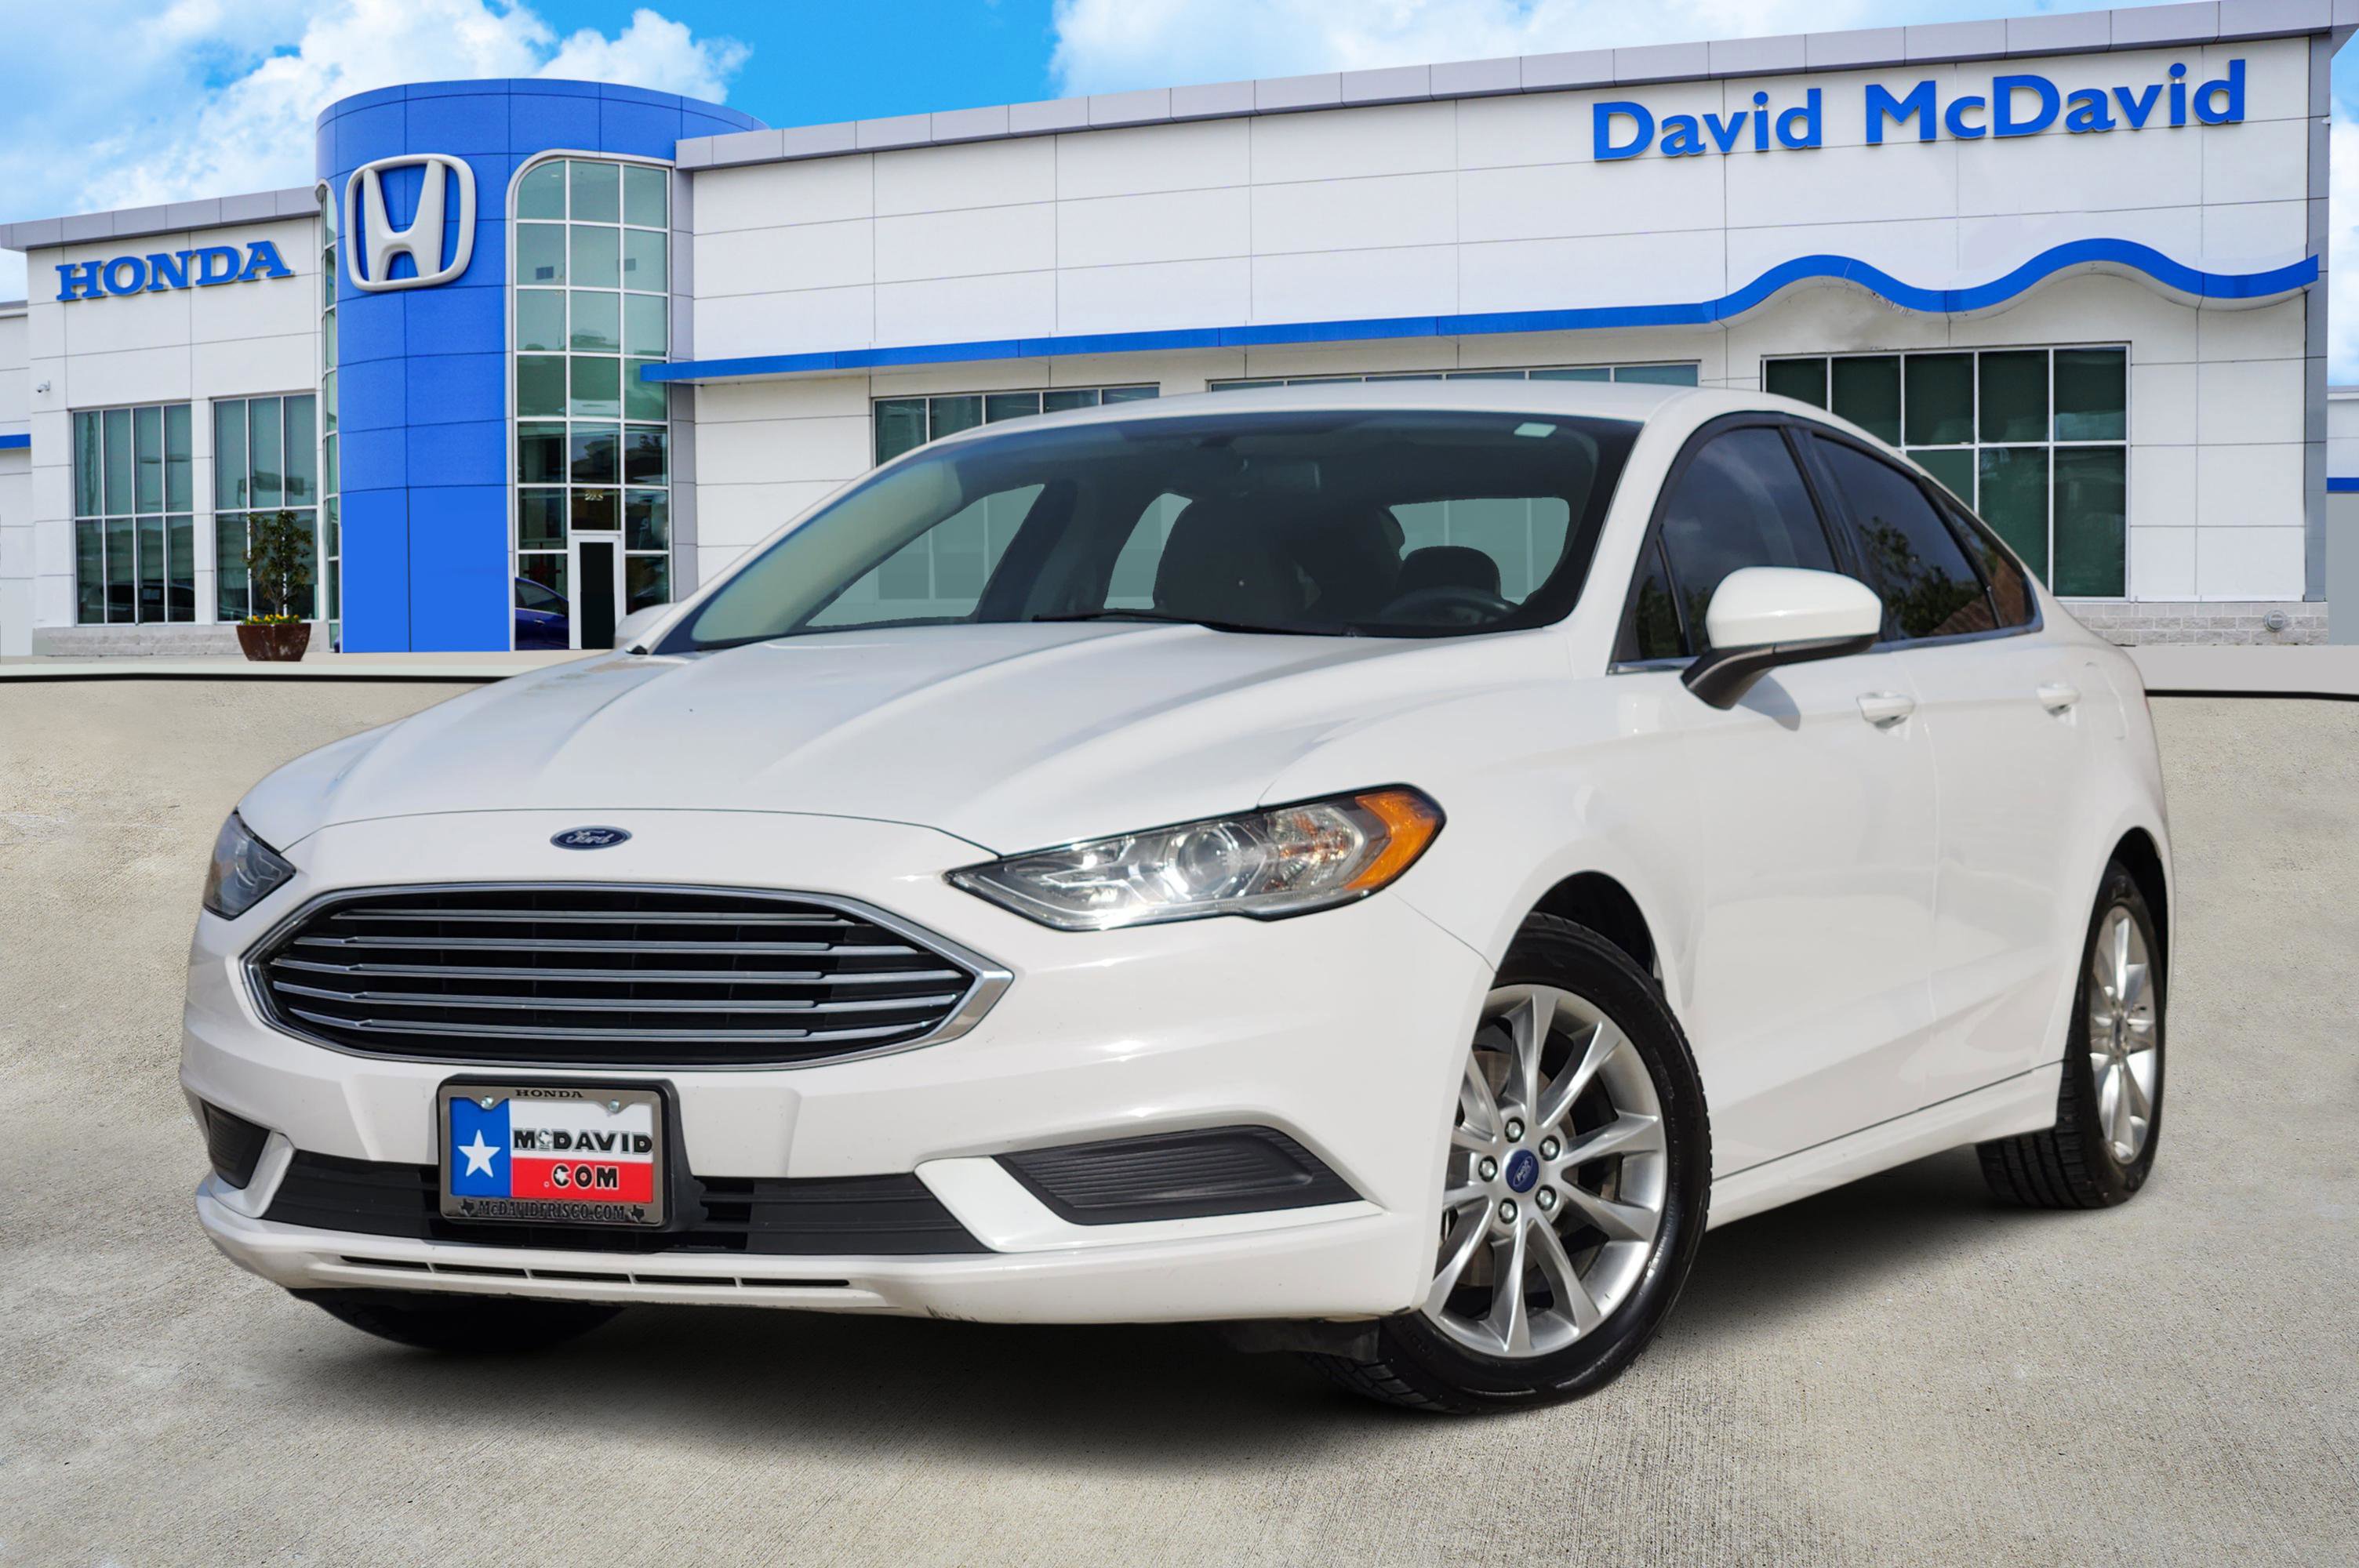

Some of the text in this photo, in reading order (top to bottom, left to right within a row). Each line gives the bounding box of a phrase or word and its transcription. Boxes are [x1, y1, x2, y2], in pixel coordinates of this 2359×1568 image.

[1592, 58, 2246, 161] David McDavid
[55, 240, 293, 302] HONDA
[565, 830, 615, 844] Ford
[515, 1089, 583, 1098] HONDA
